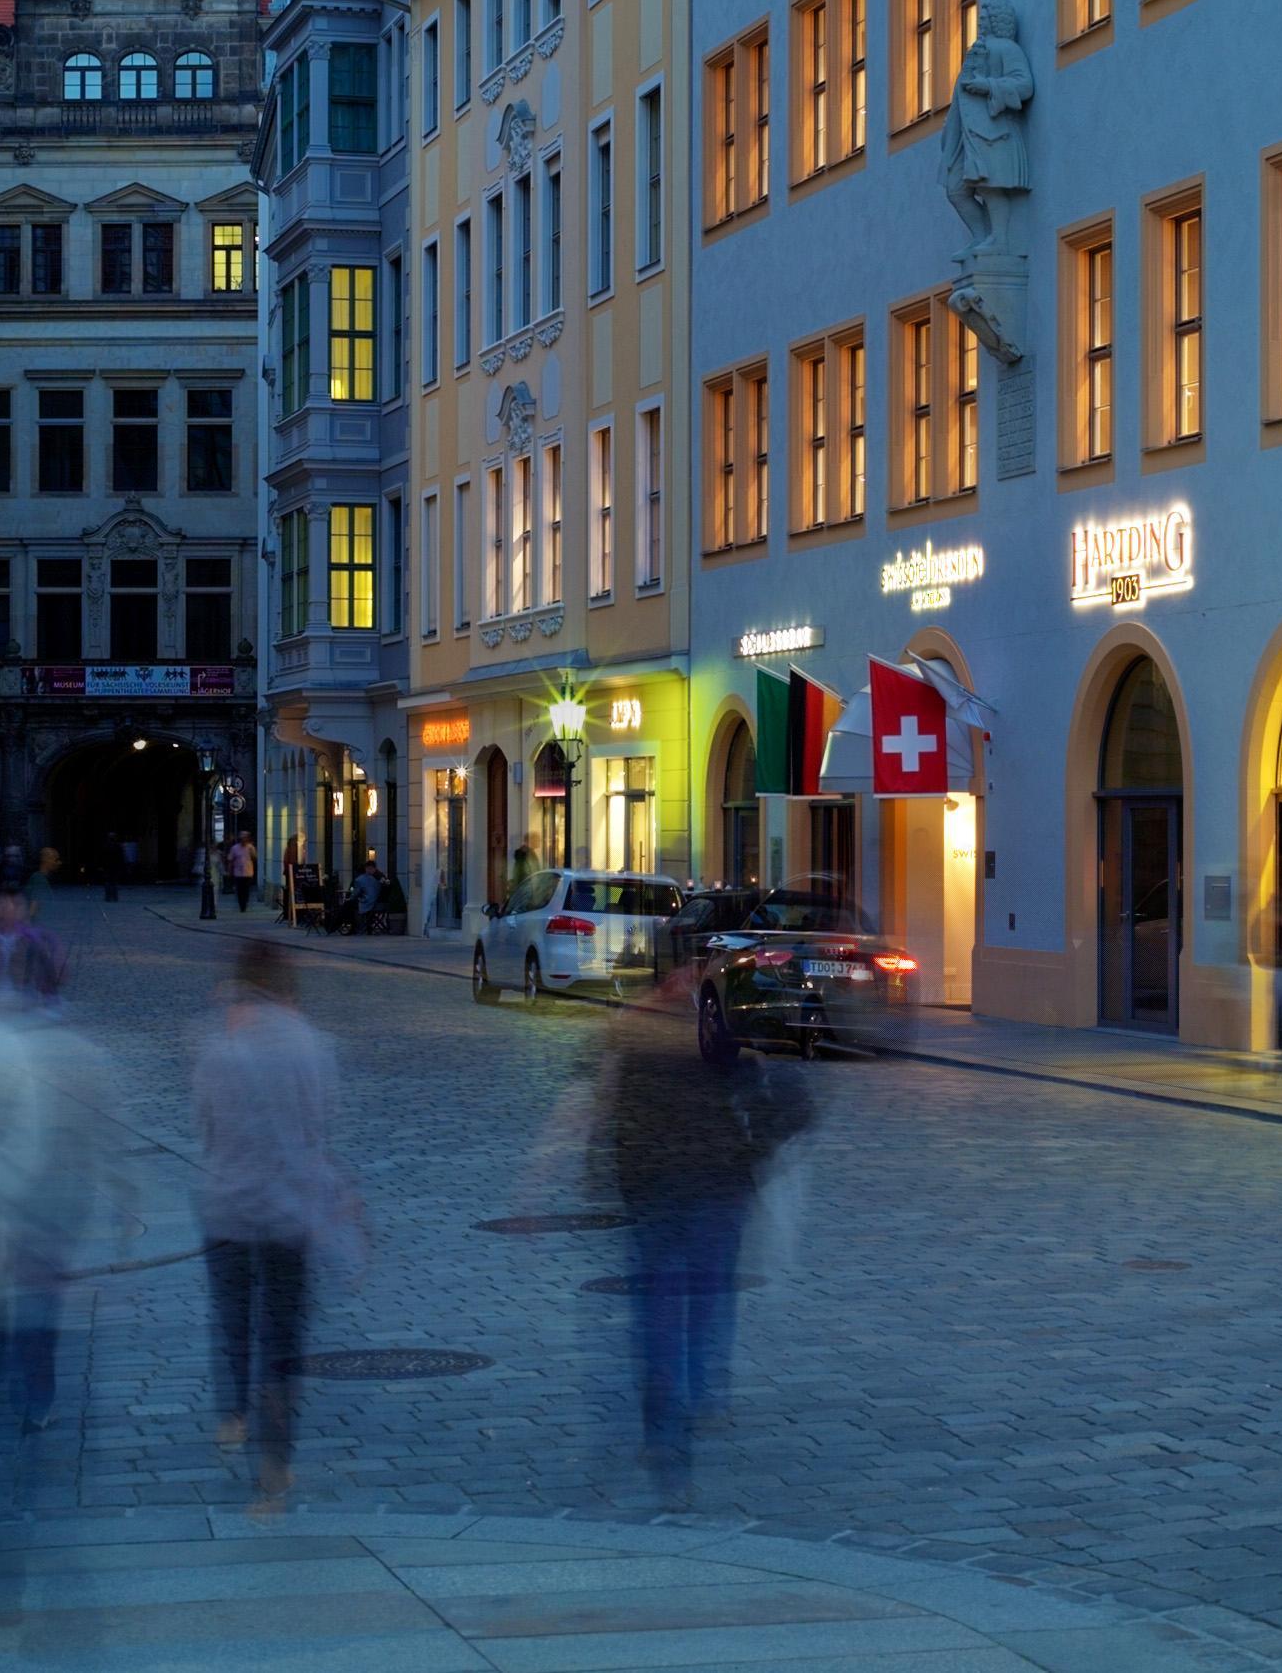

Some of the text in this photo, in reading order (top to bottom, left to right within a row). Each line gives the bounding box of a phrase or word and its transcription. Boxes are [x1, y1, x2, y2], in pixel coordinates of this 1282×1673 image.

[1071, 511, 1184, 588] HARTDING
[1111, 576, 1138, 603] 1903
[53, 681, 85, 689] MUSEUM
